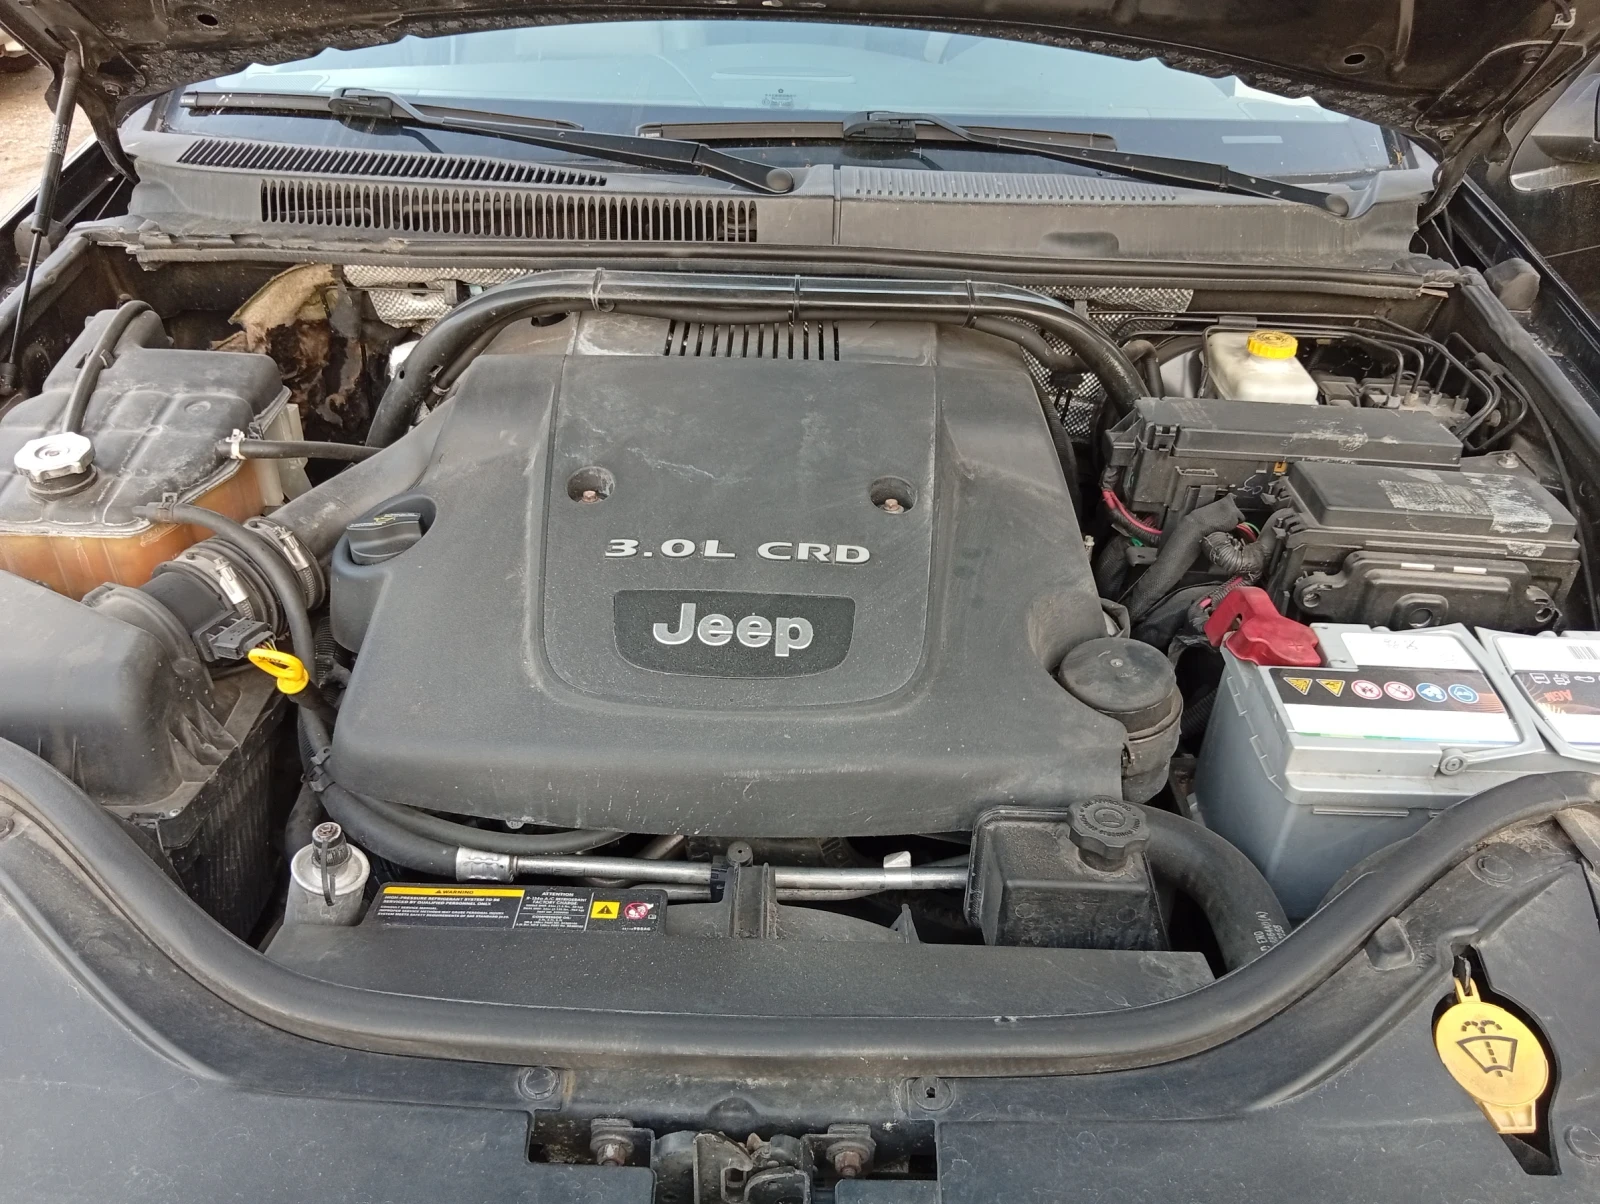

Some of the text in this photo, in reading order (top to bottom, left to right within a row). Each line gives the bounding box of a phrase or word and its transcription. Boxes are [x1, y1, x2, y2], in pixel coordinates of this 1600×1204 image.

[605, 538, 872, 565] 3.0L CRD
[653, 602, 814, 657] Jeep
[1543, 688, 1573, 702] AGM
